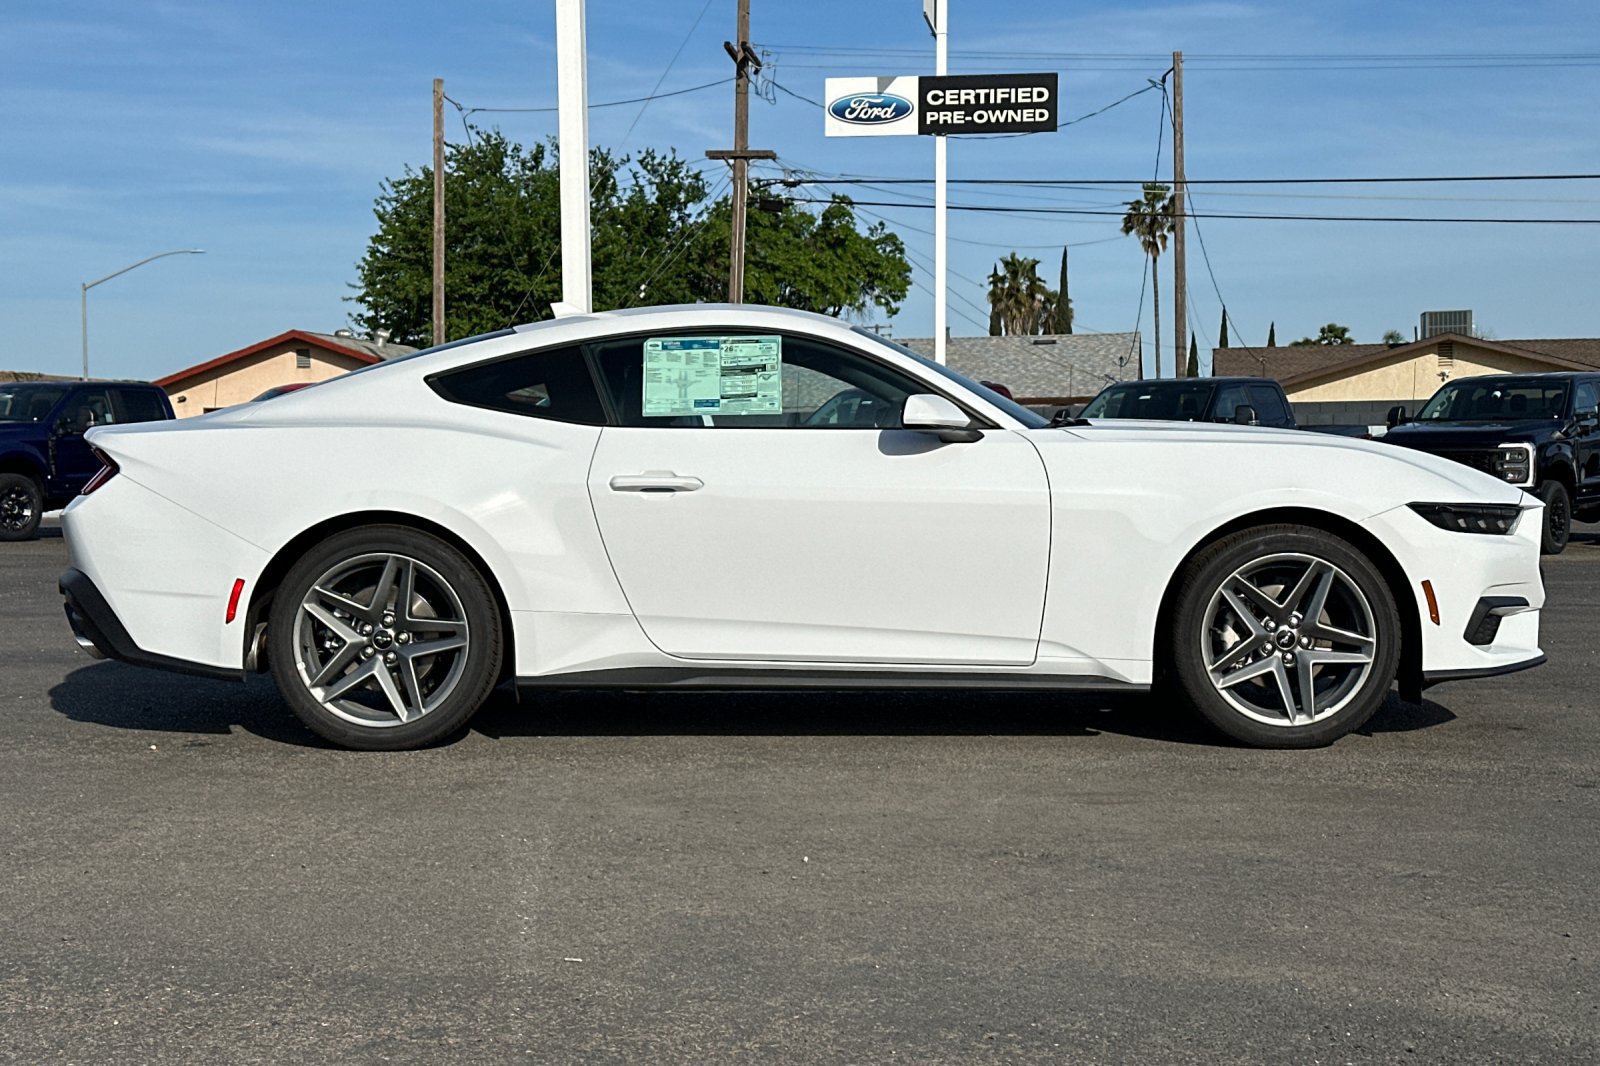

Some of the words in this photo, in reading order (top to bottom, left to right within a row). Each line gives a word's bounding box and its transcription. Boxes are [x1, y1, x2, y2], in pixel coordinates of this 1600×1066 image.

[926, 87, 1049, 105] CERTIFIED
[843, 97, 896, 120] Ford
[926, 108, 1049, 125] PRE-OWNED
